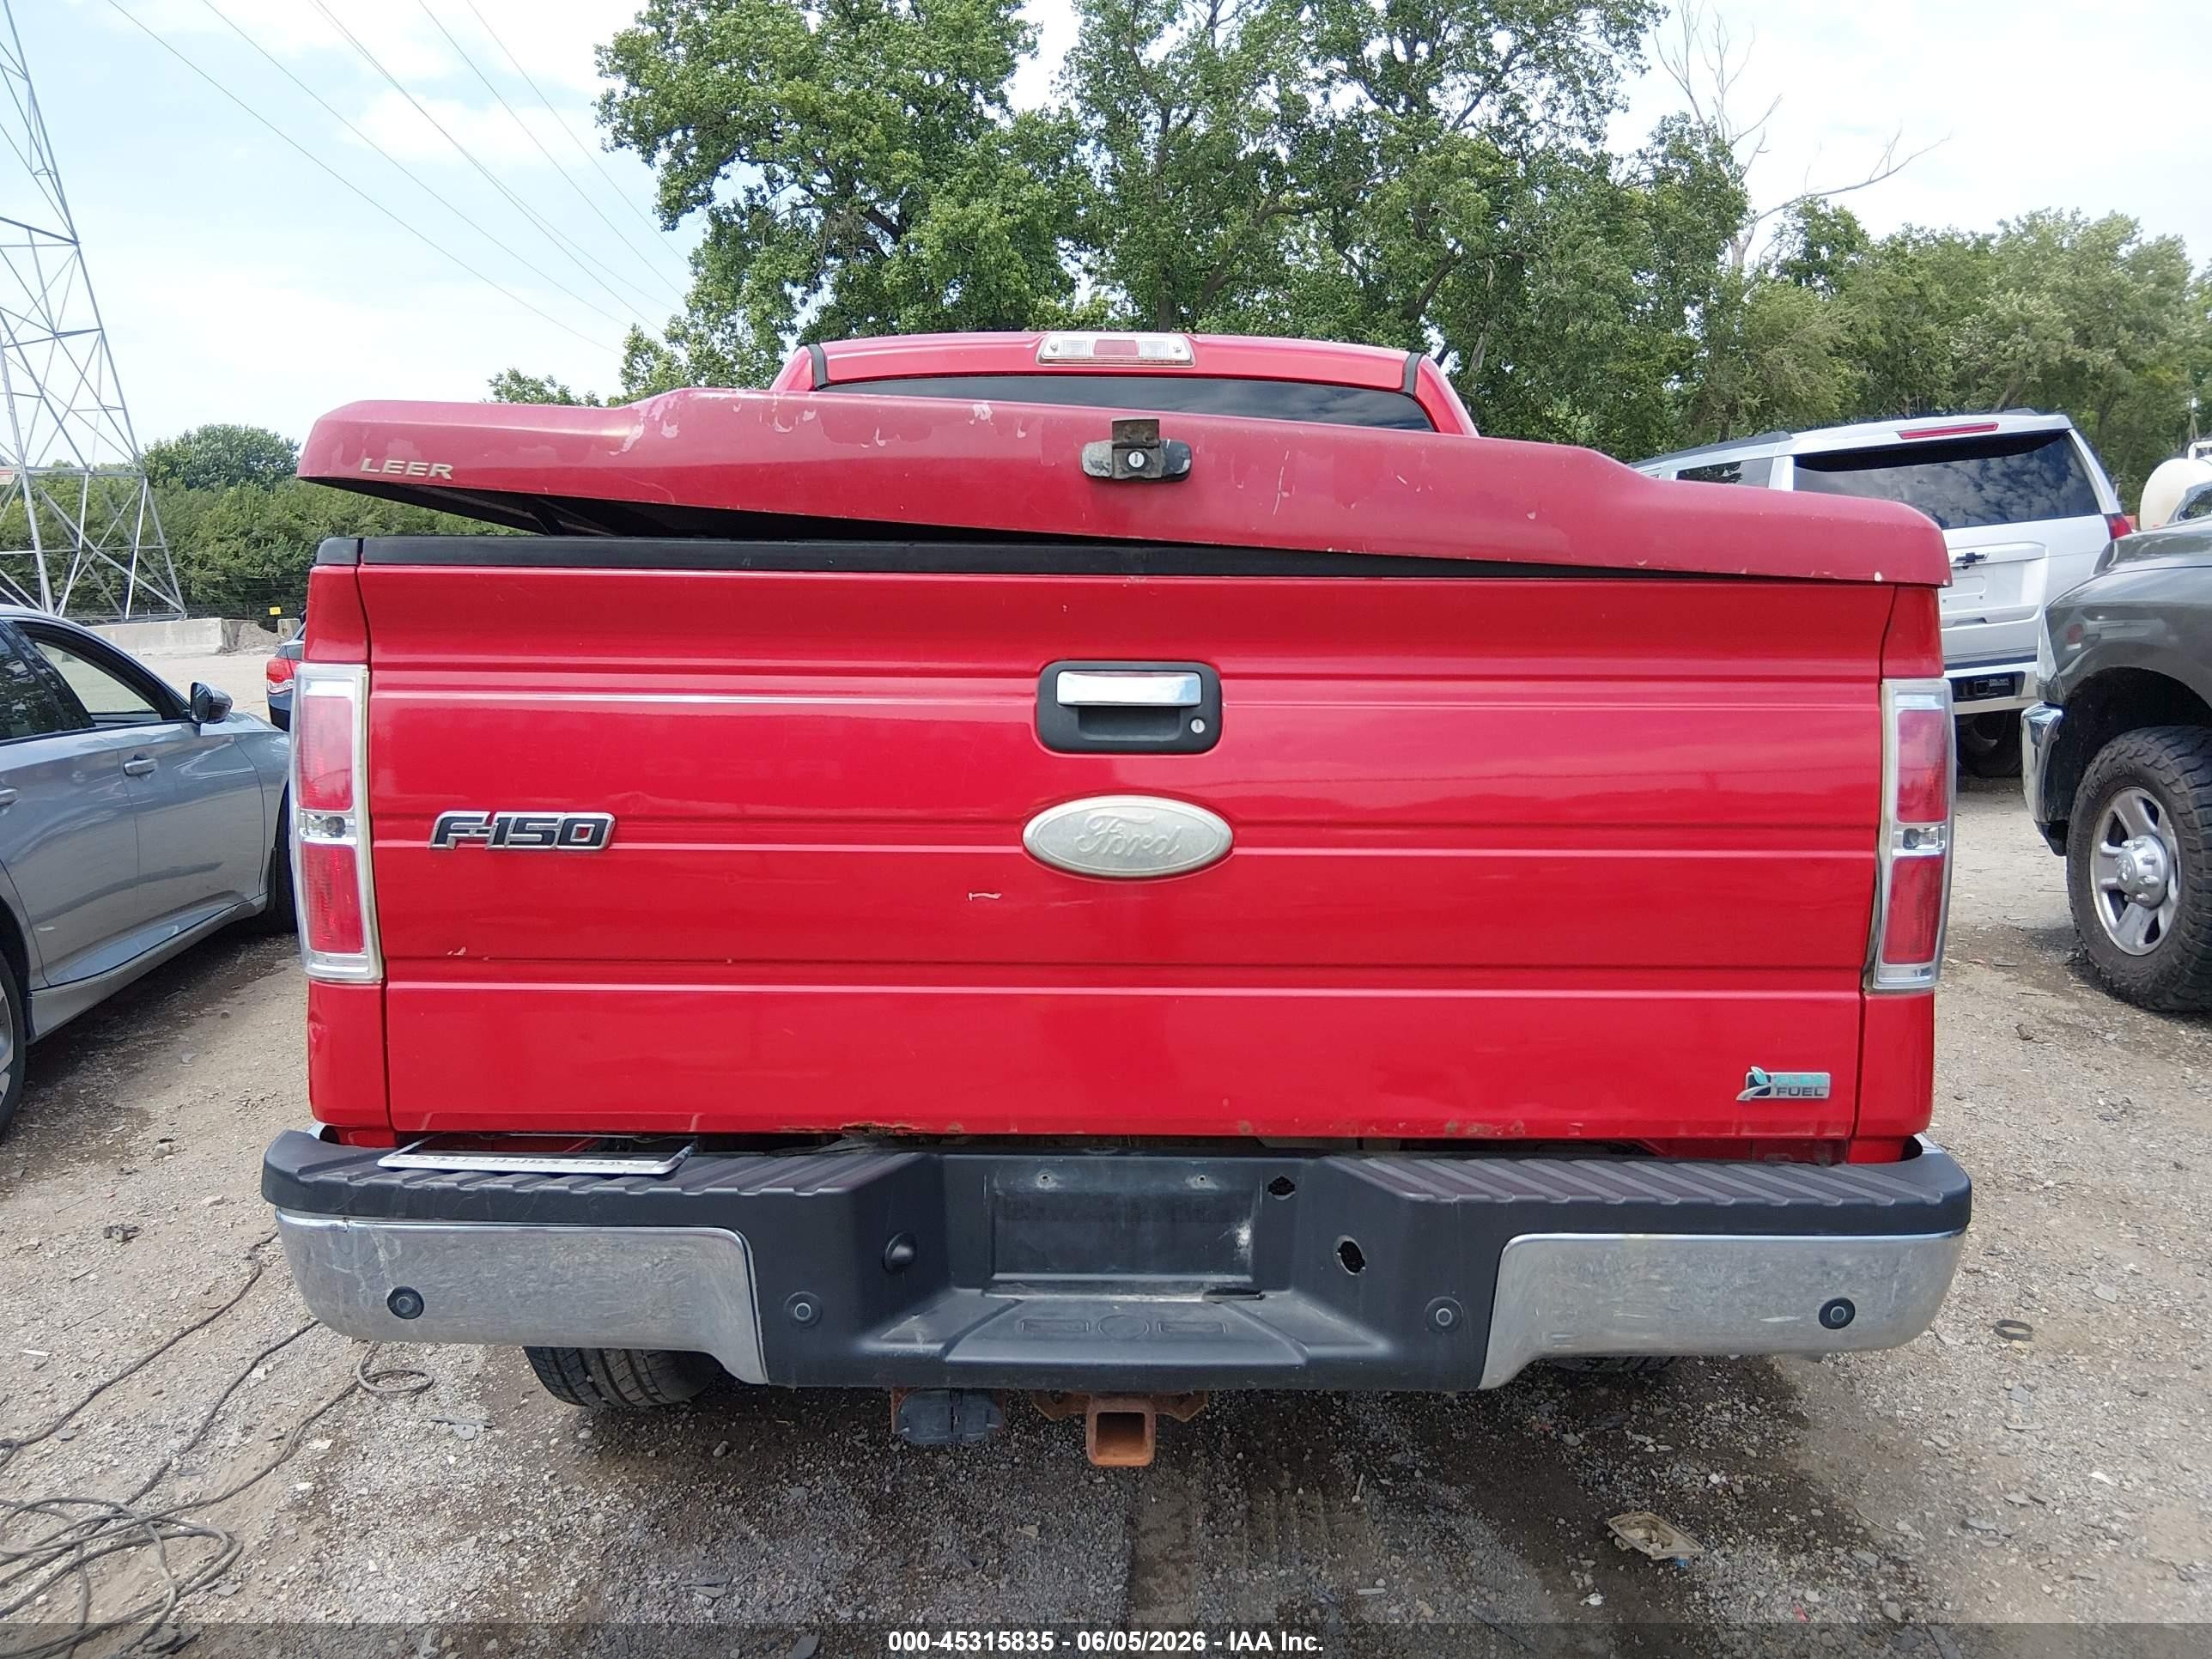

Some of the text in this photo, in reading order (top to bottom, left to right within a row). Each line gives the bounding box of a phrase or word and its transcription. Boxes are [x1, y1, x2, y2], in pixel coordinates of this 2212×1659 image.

[361, 458, 453, 480] LEER
[431, 811, 616, 849] F-150
[1075, 814, 1182, 856] Ford
[1776, 1086, 1824, 1097] FUEL
